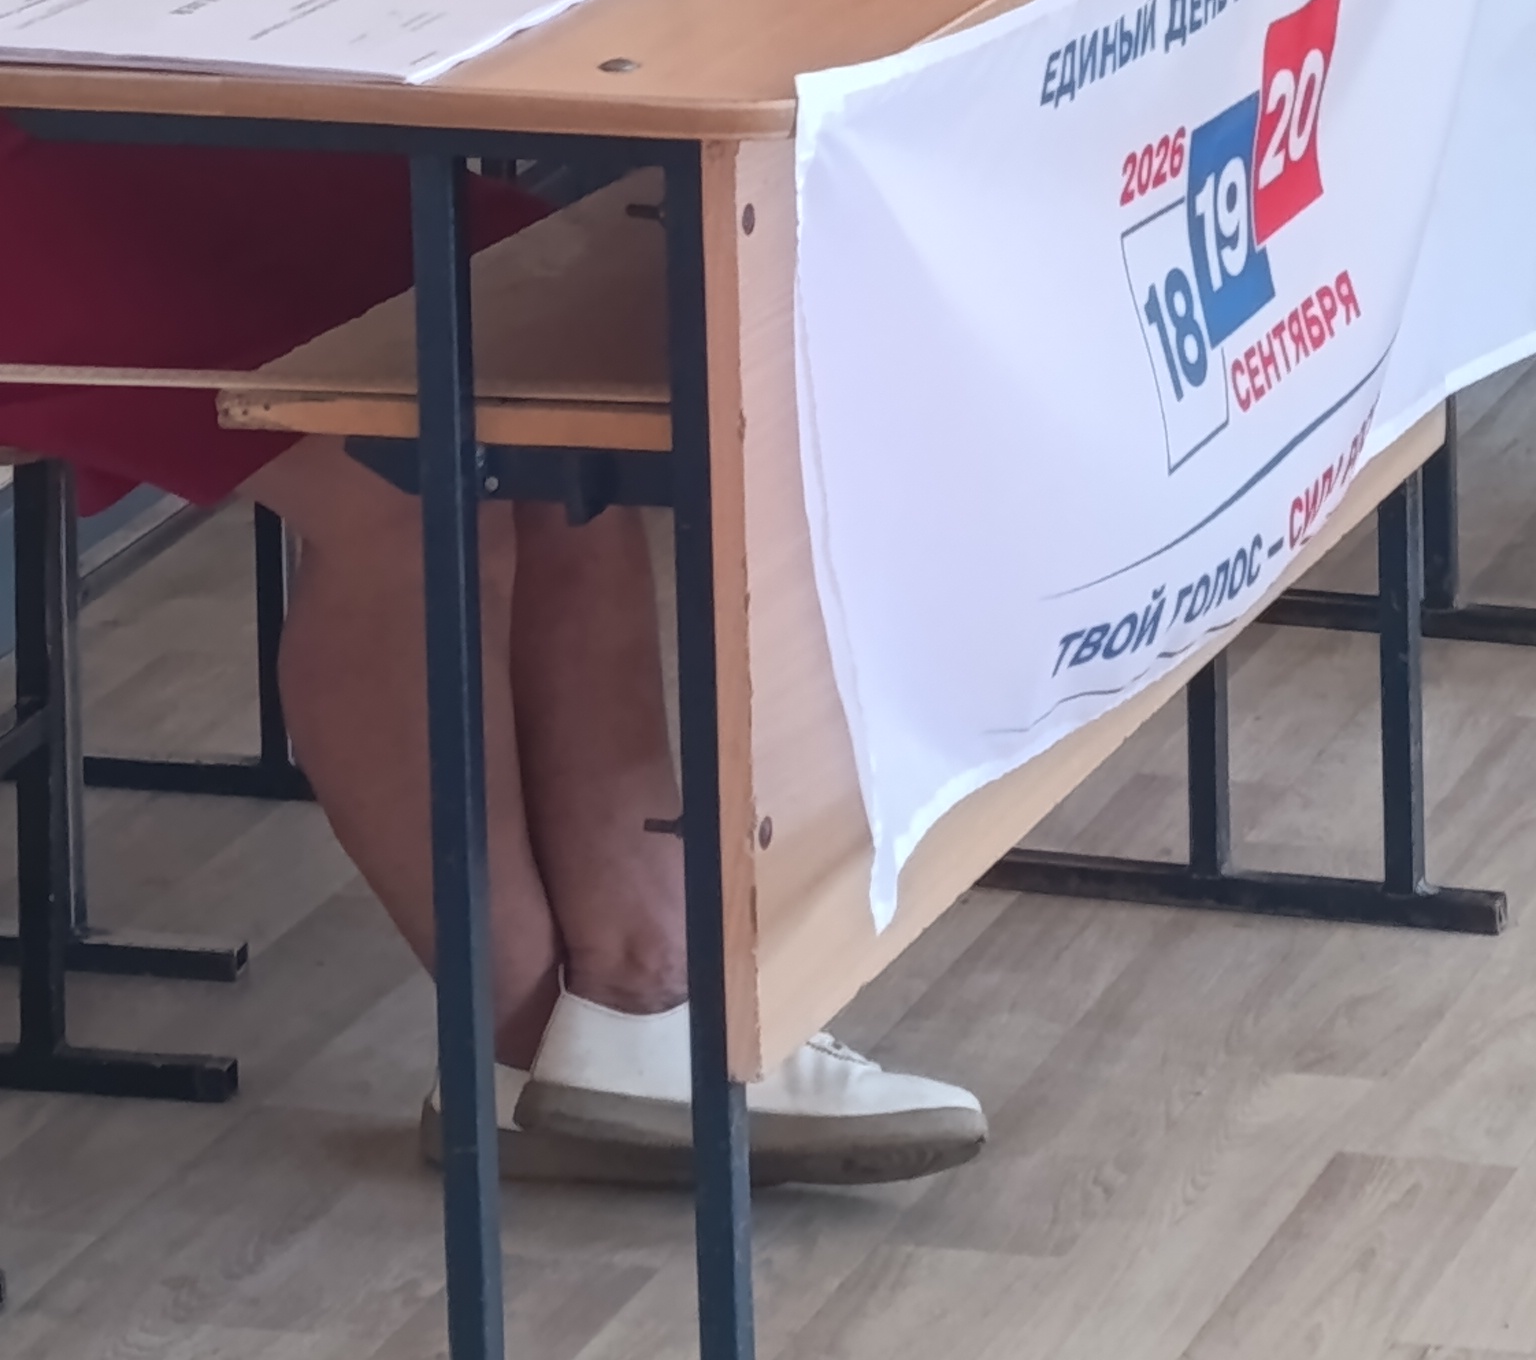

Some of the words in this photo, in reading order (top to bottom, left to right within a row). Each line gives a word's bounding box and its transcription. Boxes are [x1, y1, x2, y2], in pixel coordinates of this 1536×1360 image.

[1120, 126, 1186, 206] 2026
[1258, 48, 1324, 190] 20
[1195, 156, 1248, 293] 19
[1144, 267, 1208, 402] 18
[1231, 269, 1361, 413] СЕНТЯБРЯ
[1052, 582, 1166, 678] ТВОЙ
[1167, 533, 1262, 631] ГОЛОС
